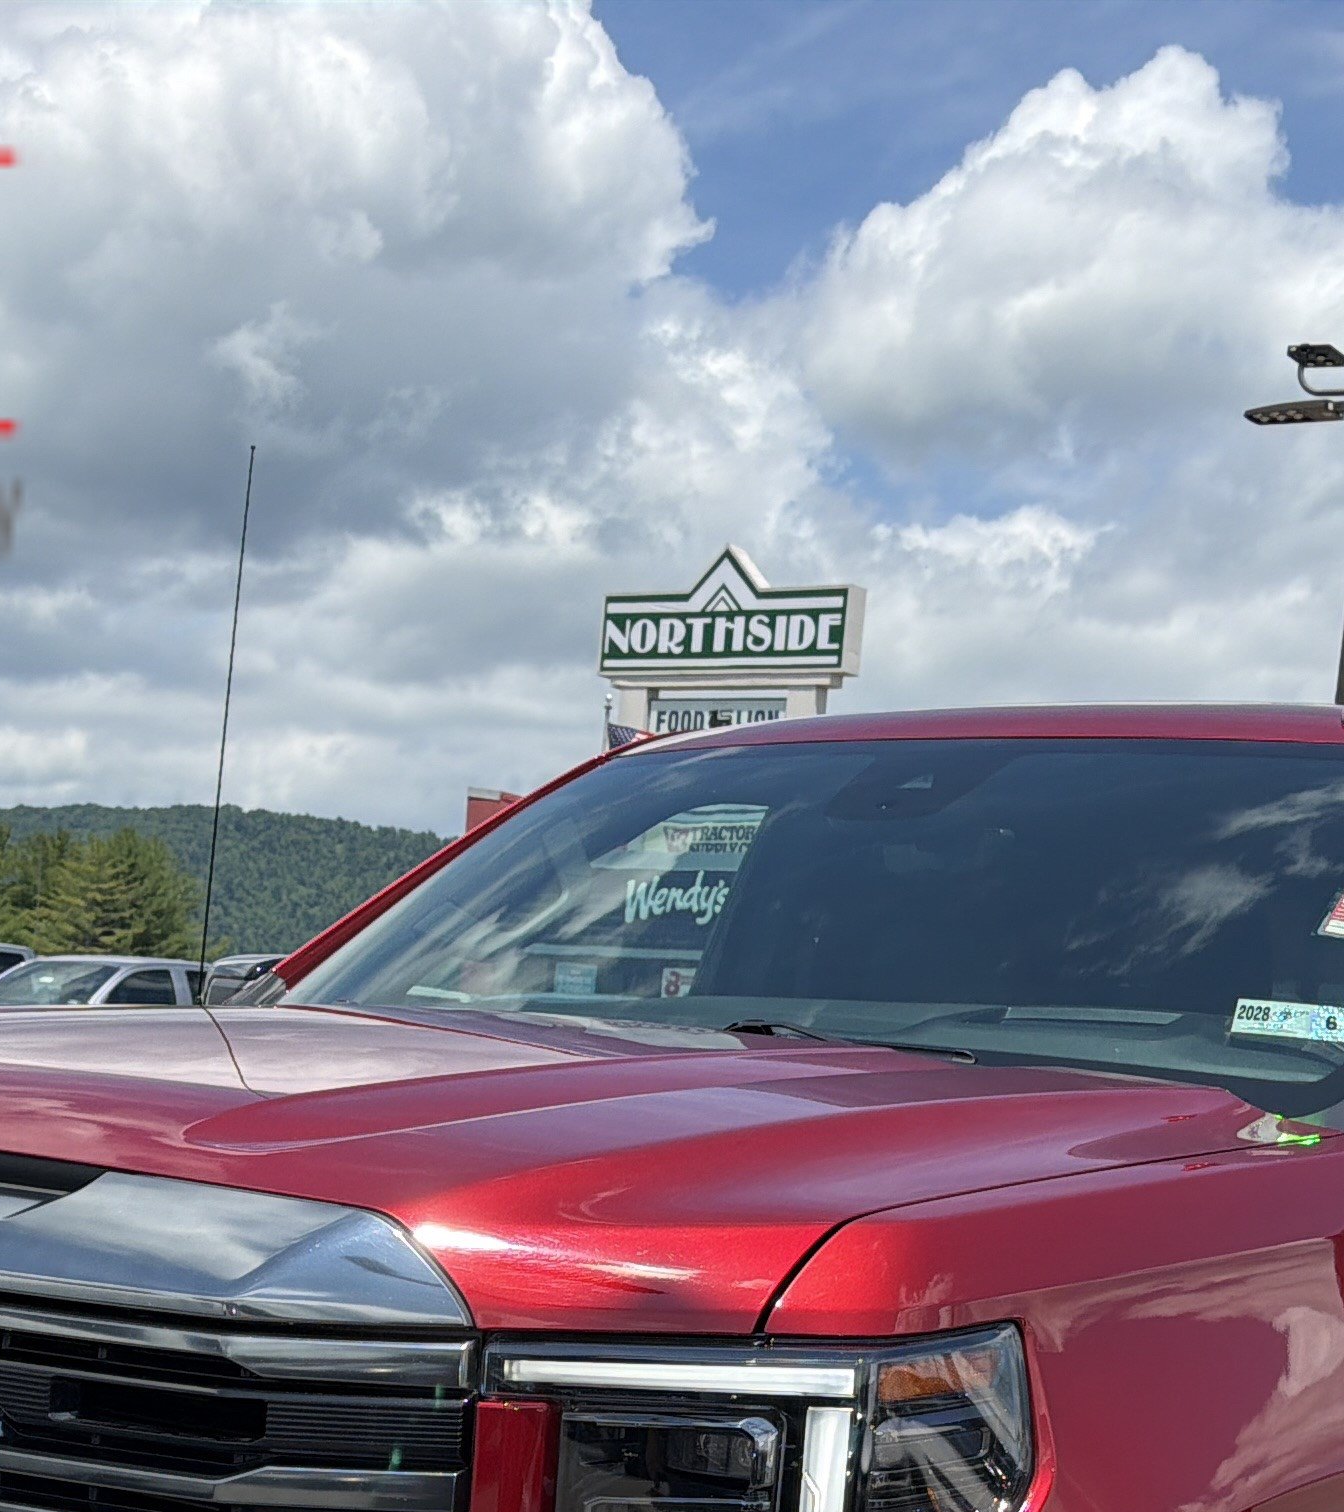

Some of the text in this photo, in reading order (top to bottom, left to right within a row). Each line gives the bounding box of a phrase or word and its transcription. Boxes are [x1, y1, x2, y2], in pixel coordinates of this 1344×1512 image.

[603, 612, 842, 655] NORTHSIDE
[656, 709, 705, 733] FOOD
[624, 869, 730, 926] Wendy's
[1237, 1004, 1271, 1021] 2028
[1325, 1015, 1338, 1030] 6
